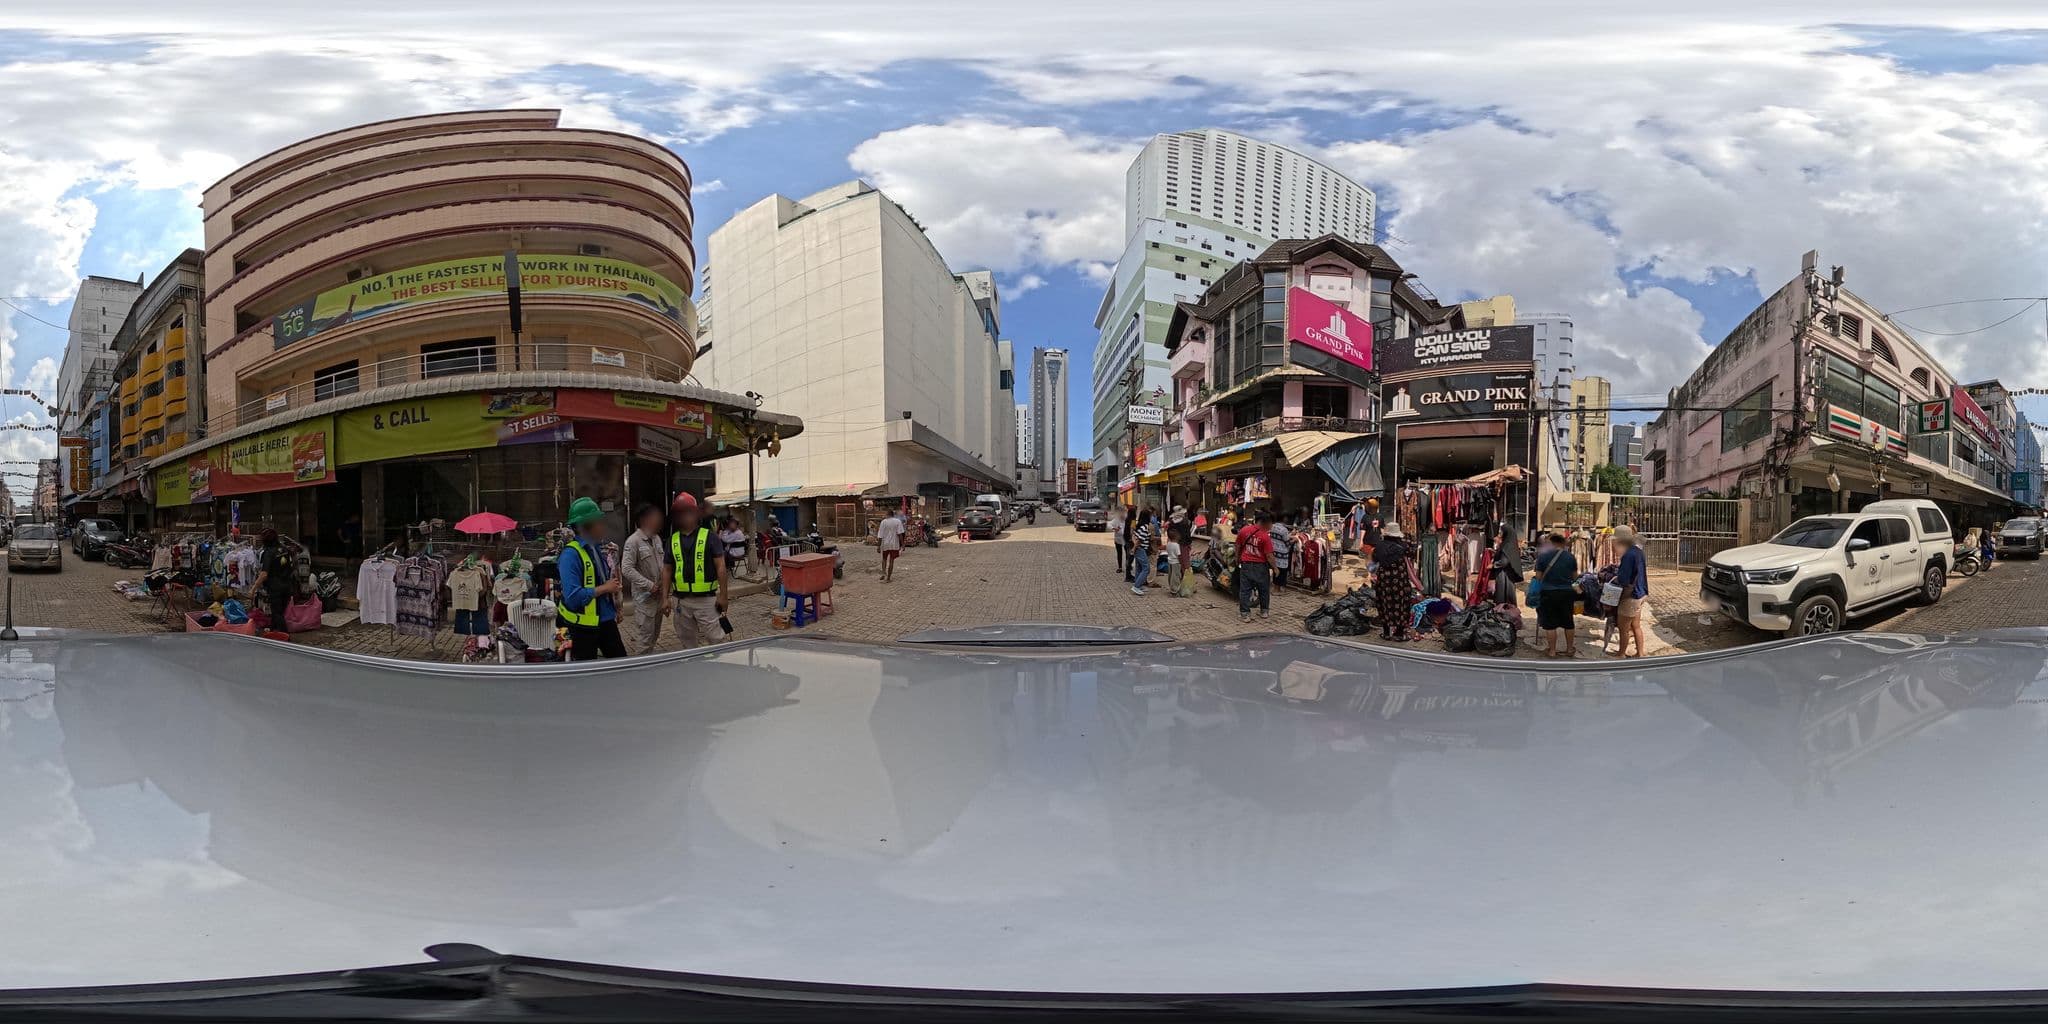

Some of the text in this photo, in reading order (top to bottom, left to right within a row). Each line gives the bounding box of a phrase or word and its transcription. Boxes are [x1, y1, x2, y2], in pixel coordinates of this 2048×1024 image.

[361, 273, 395, 296] NO.1
[398, 271, 423, 286] THE
[427, 263, 487, 280] FASTEST
[574, 262, 589, 273] IN
[593, 263, 656, 288] THAILAND
[391, 273, 629, 301] THE BEST SELLE FOR TOURISTS
[290, 307, 304, 318] AIS
[282, 315, 305, 337] 5G
[1305, 326, 1364, 361] GRAND PINK
[1414, 329, 1491, 347] NOW YOU
[1414, 339, 1491, 358] CAN SING
[1420, 352, 1483, 365] KTV KARAOKE
[1420, 387, 1527, 405] GRAND PINK
[1494, 402, 1527, 411] HOTEL
[373, 406, 430, 430] & CALL
[232, 436, 289, 459] AVAILABLE HERE!
